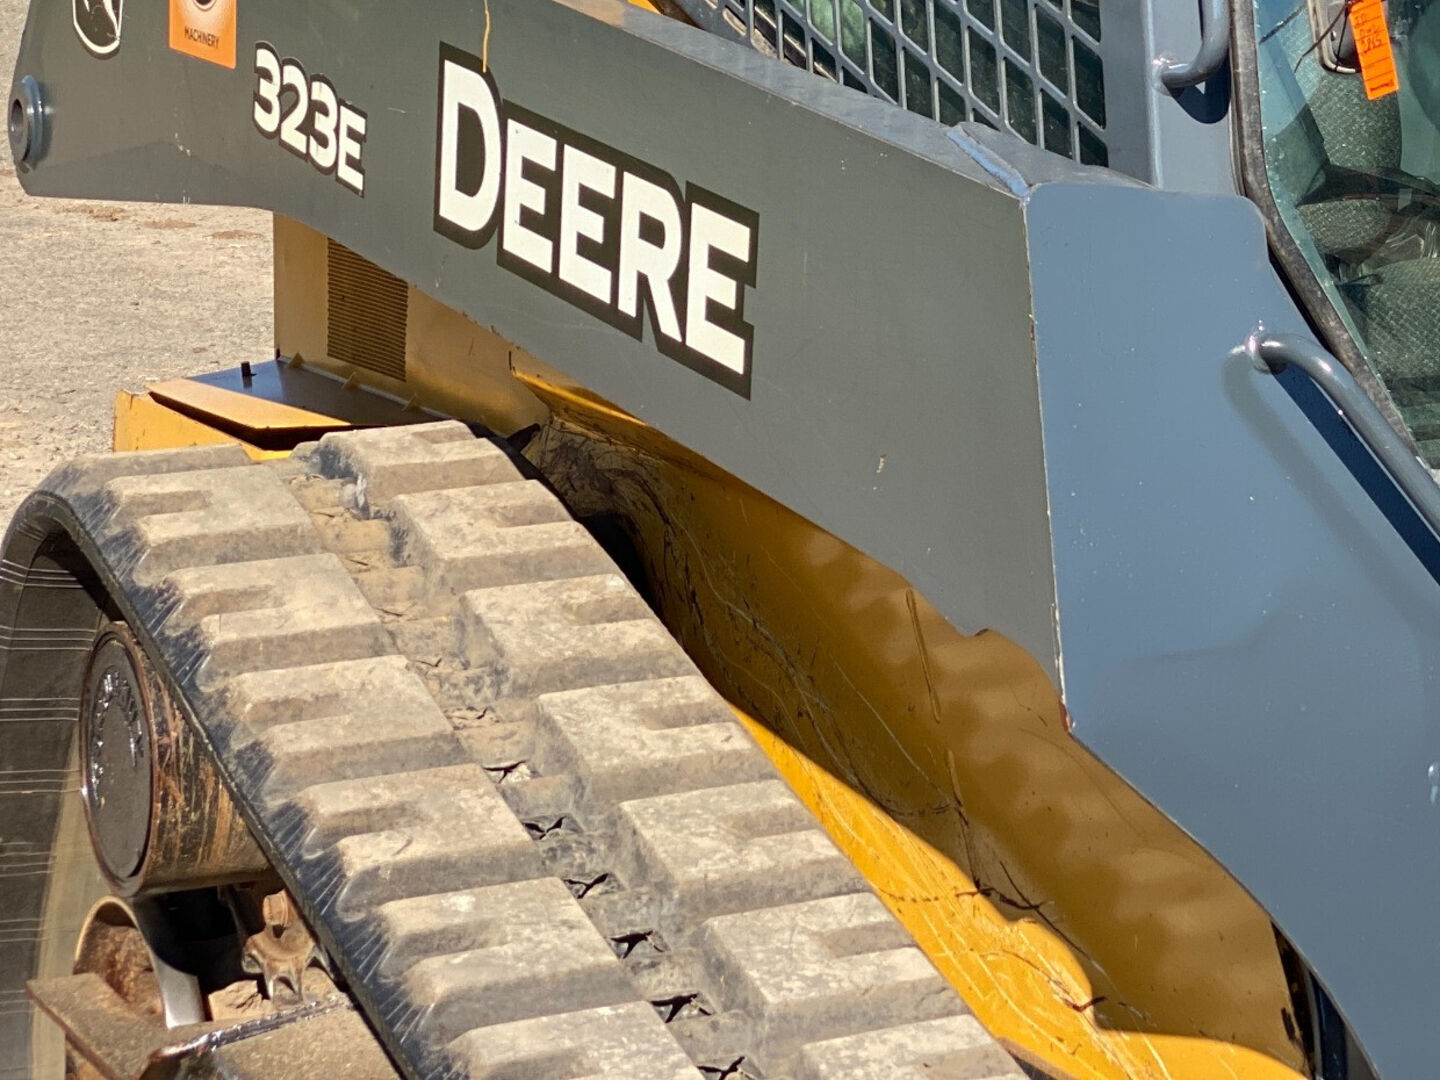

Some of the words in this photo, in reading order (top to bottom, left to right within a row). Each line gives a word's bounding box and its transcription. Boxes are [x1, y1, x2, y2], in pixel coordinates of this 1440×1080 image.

[184, 25, 219, 49] MACHINERY
[253, 47, 367, 192] 323E
[438, 59, 751, 375] DEERE
